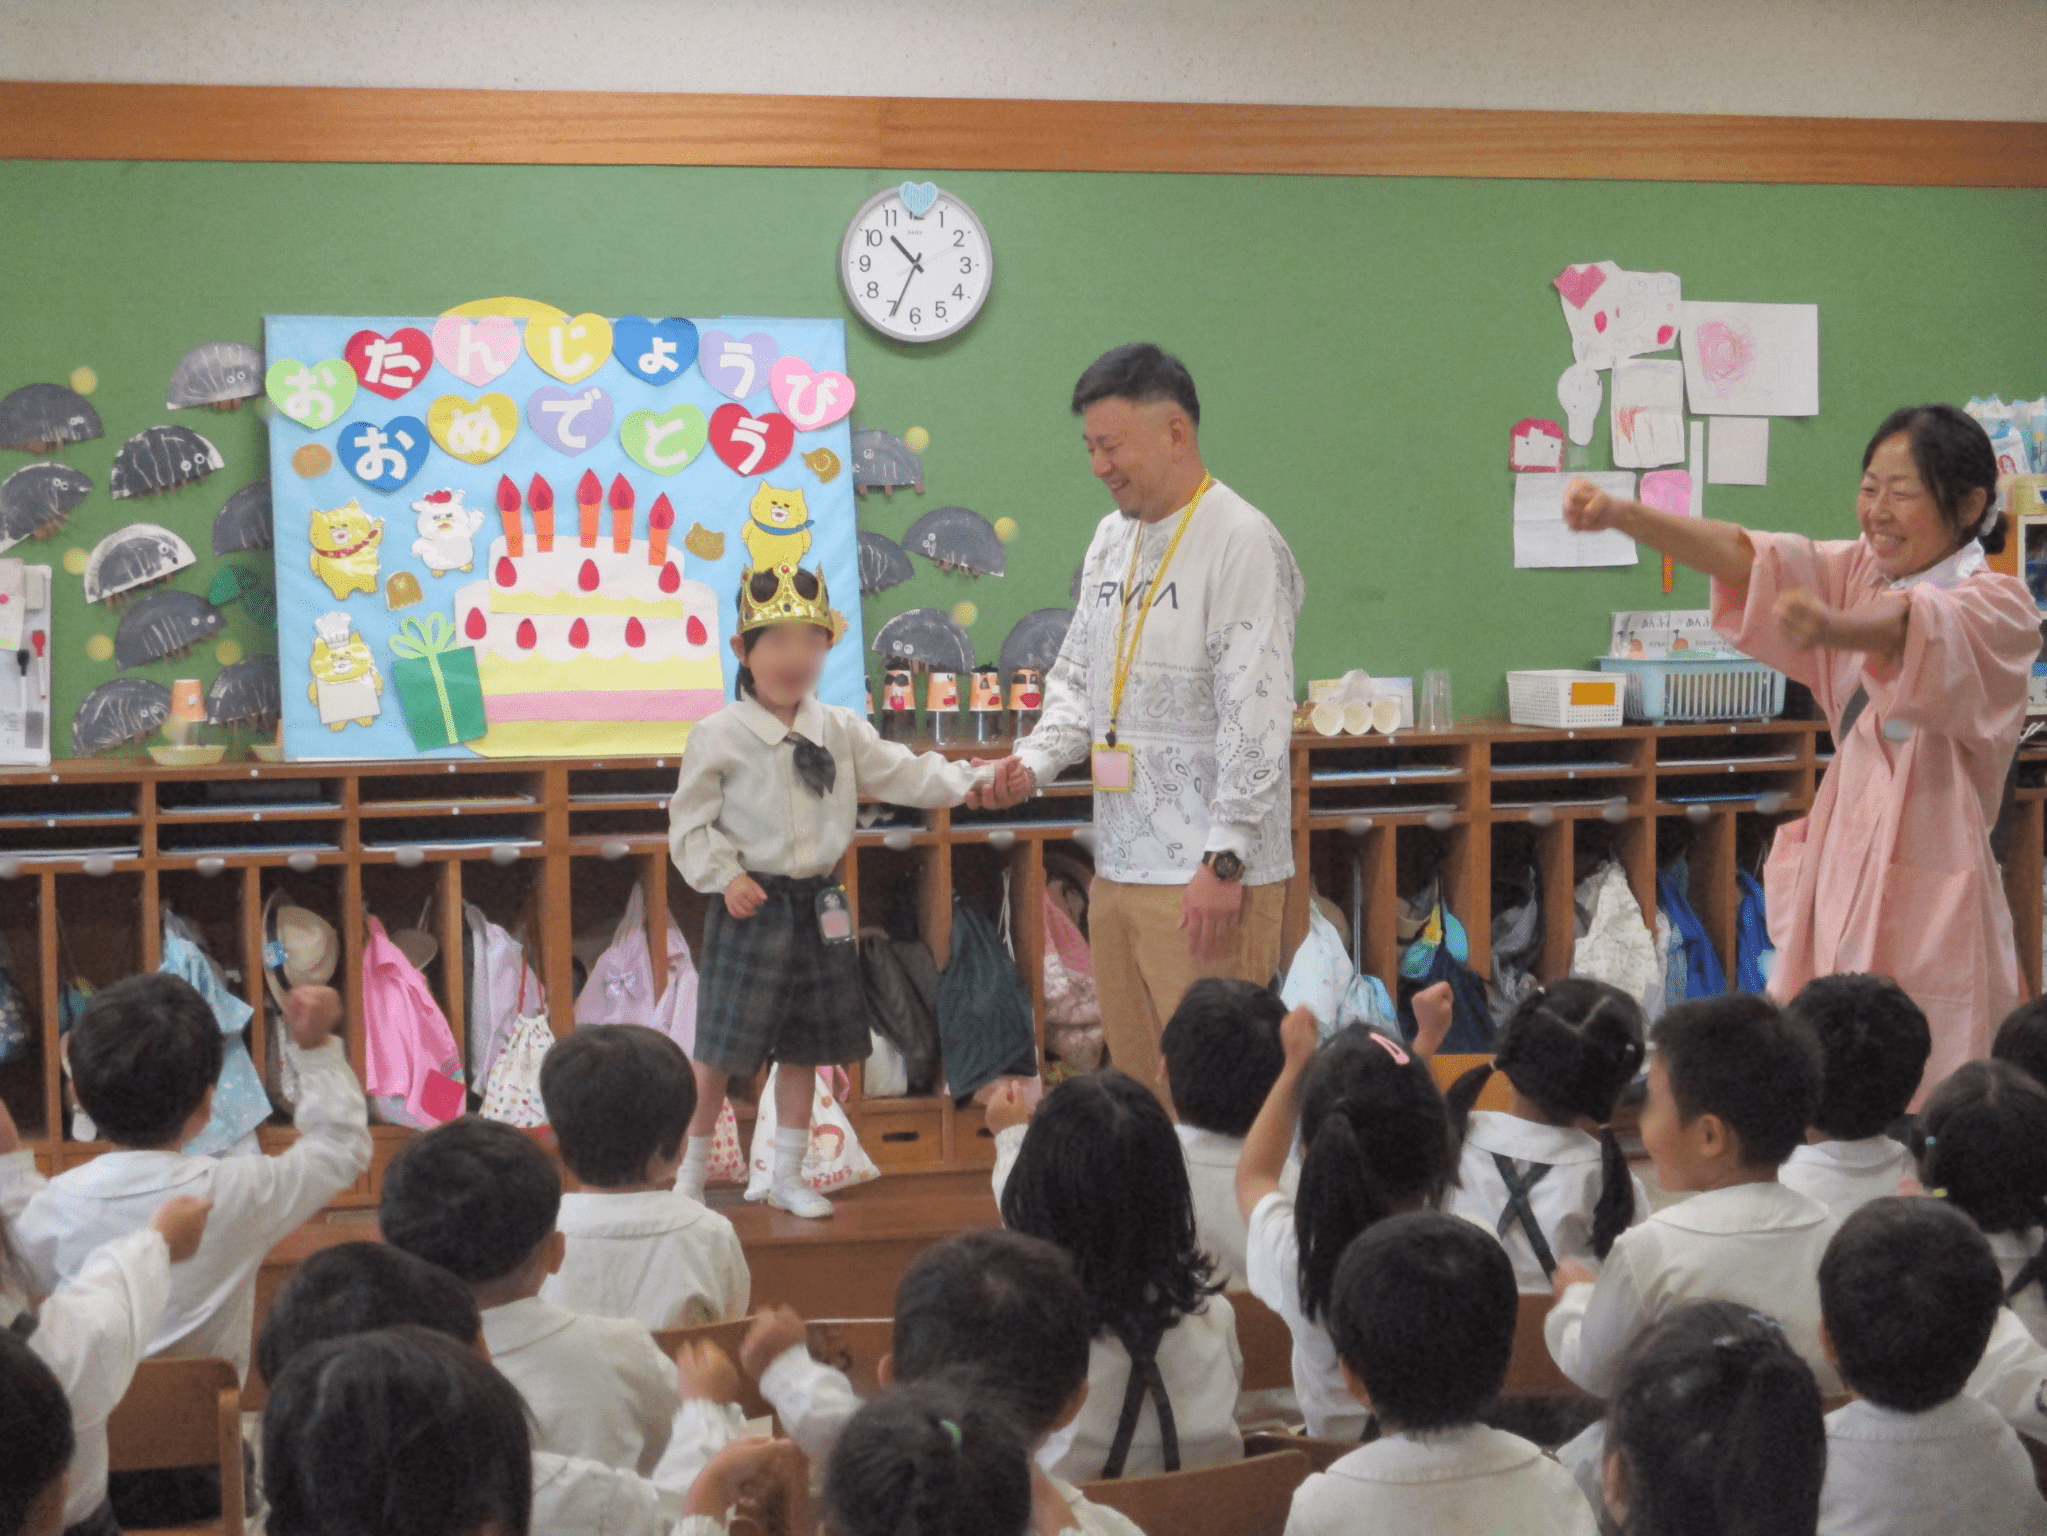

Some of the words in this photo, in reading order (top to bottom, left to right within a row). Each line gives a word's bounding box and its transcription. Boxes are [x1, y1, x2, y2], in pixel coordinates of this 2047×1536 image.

[884, 209, 897, 227] 11
[939, 211, 944, 228] 1
[865, 229, 883, 247] 10
[953, 229, 965, 247] 2
[859, 254, 871, 273] 9
[959, 256, 972, 274] 3
[866, 281, 879, 298] 8
[951, 283, 964, 300] 4
[886, 300, 898, 317] 7
[909, 307, 921, 325] 6
[935, 301, 947, 318] 5
[284, 324, 839, 424] おたんじょうび
[354, 387, 769, 481] おめでとう
